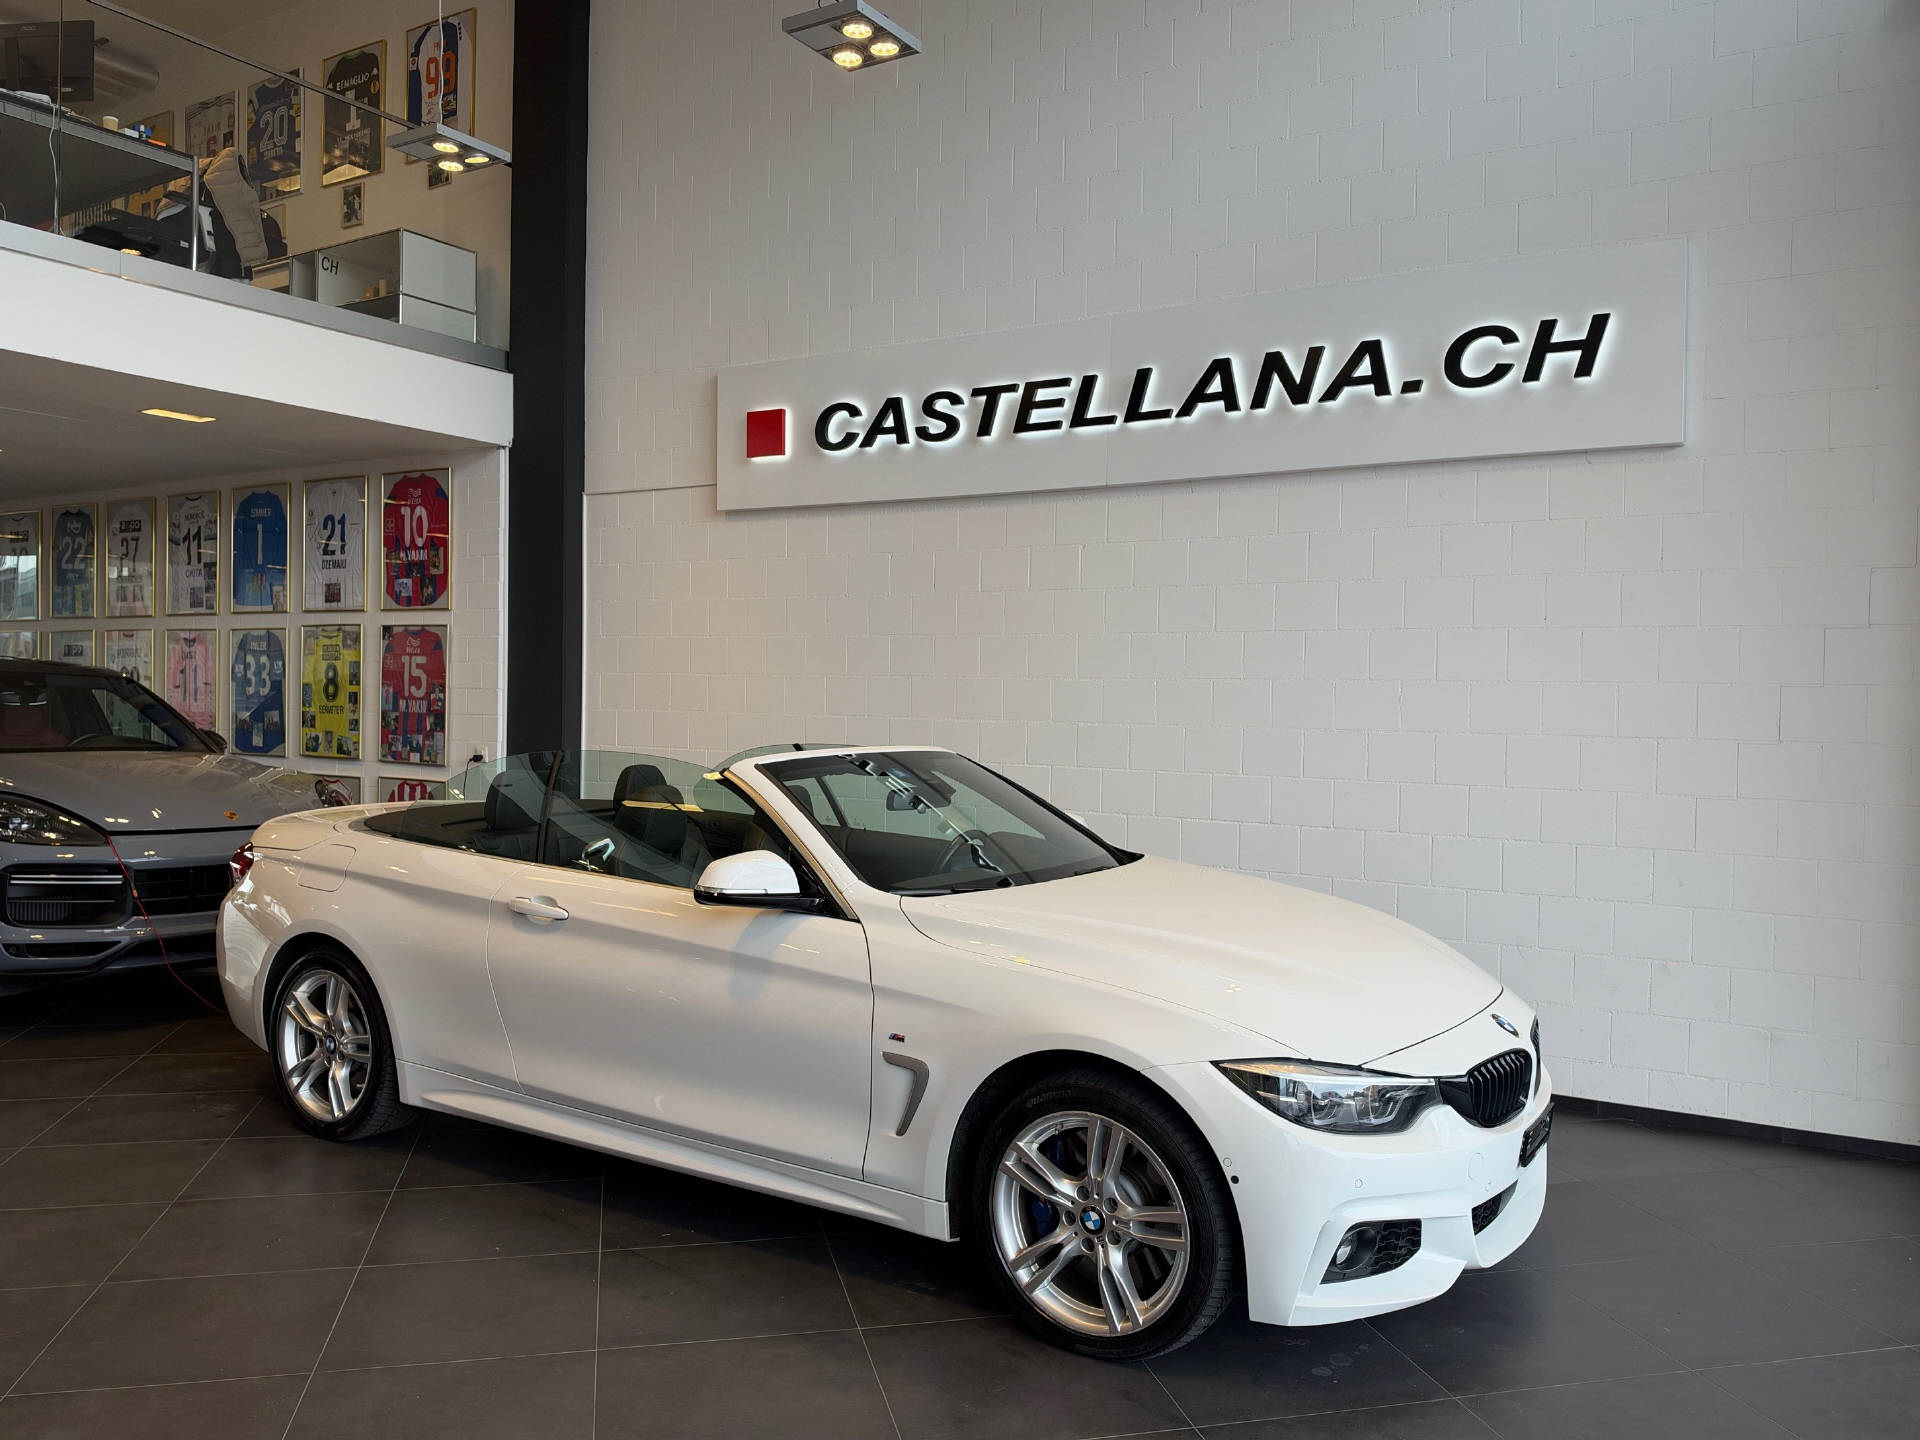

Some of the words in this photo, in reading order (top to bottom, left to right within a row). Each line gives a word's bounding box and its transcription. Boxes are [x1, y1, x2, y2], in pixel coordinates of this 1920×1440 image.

[425, 50, 456, 99] 99
[259, 106, 289, 153] 20
[321, 256, 339, 275] CH
[814, 312, 1611, 452] CASTELLANA.CH
[182, 525, 202, 566] 11
[257, 523, 263, 565] 1
[322, 513, 346, 556] 21
[401, 505, 429, 547] 10
[61, 536, 85, 569] 22
[180, 664, 198, 703] 11
[245, 655, 271, 697] 33
[322, 662, 339, 702] 8
[401, 655, 427, 698] 15
